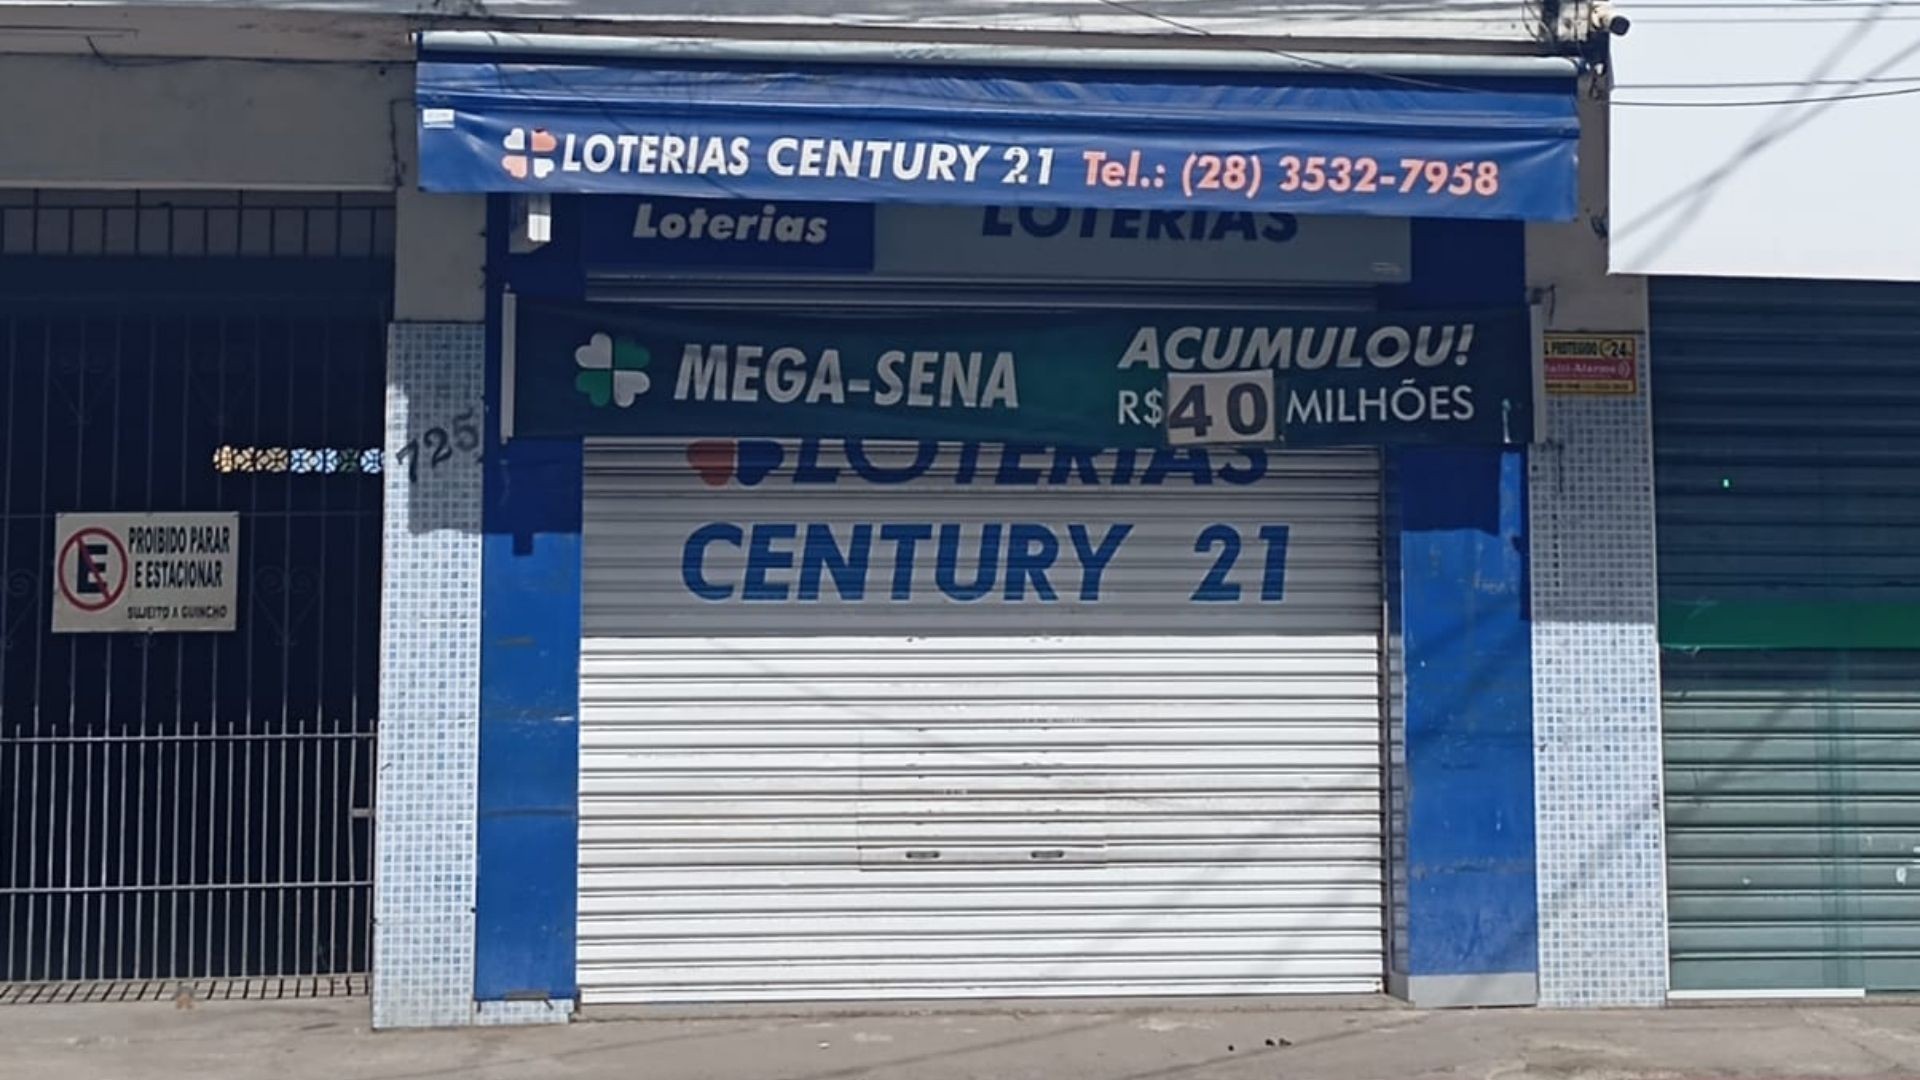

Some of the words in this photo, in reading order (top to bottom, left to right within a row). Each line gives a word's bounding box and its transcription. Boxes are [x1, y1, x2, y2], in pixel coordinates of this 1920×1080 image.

[562, 134, 751, 177] LOTERIAS
[766, 137, 991, 183] CENTURY
[1002, 146, 1054, 186] 21
[1083, 150, 1166, 189] Tel.:
[1181, 152, 1263, 199] (28)
[1278, 155, 1500, 197] 3532-7958
[633, 204, 828, 245] Loterias
[1117, 323, 1475, 370] ACUMULOU!
[673, 344, 1019, 409] MEGA-SENA
[1168, 382, 1268, 437] 40
[1286, 379, 1475, 425] MILHÕES
[395, 407, 479, 483] 725
[128, 526, 187, 554] PROIBIDO
[190, 526, 230, 554] PARAR
[681, 522, 1133, 602] CENTURY
[1190, 523, 1290, 602] 21
[134, 561, 142, 588] E
[145, 560, 223, 588] ESTACIONAR
[127, 606, 169, 620] SUJEITO
[171, 607, 179, 619] A
[181, 606, 227, 620] GUINCHO
